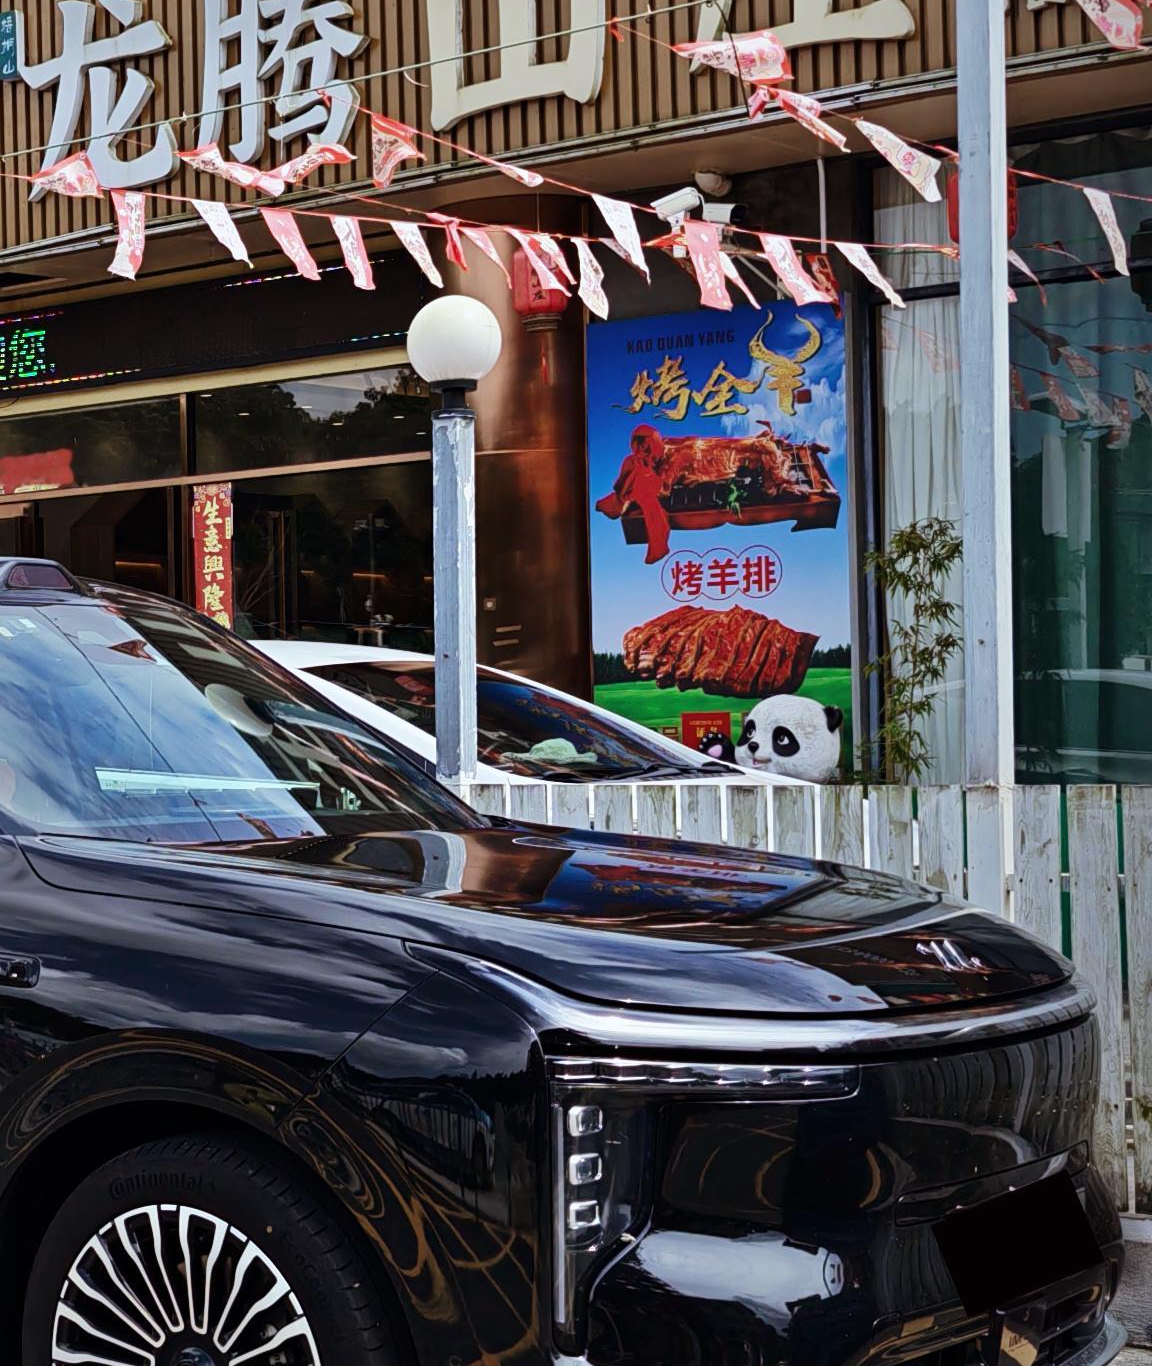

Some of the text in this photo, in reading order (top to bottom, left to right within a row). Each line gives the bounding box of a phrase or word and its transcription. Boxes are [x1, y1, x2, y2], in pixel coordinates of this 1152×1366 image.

[626, 337, 653, 354] KAO
[698, 330, 735, 347] YANG
[611, 311, 824, 421] 烤全羊
[671, 556, 777, 595] 烤羊排
